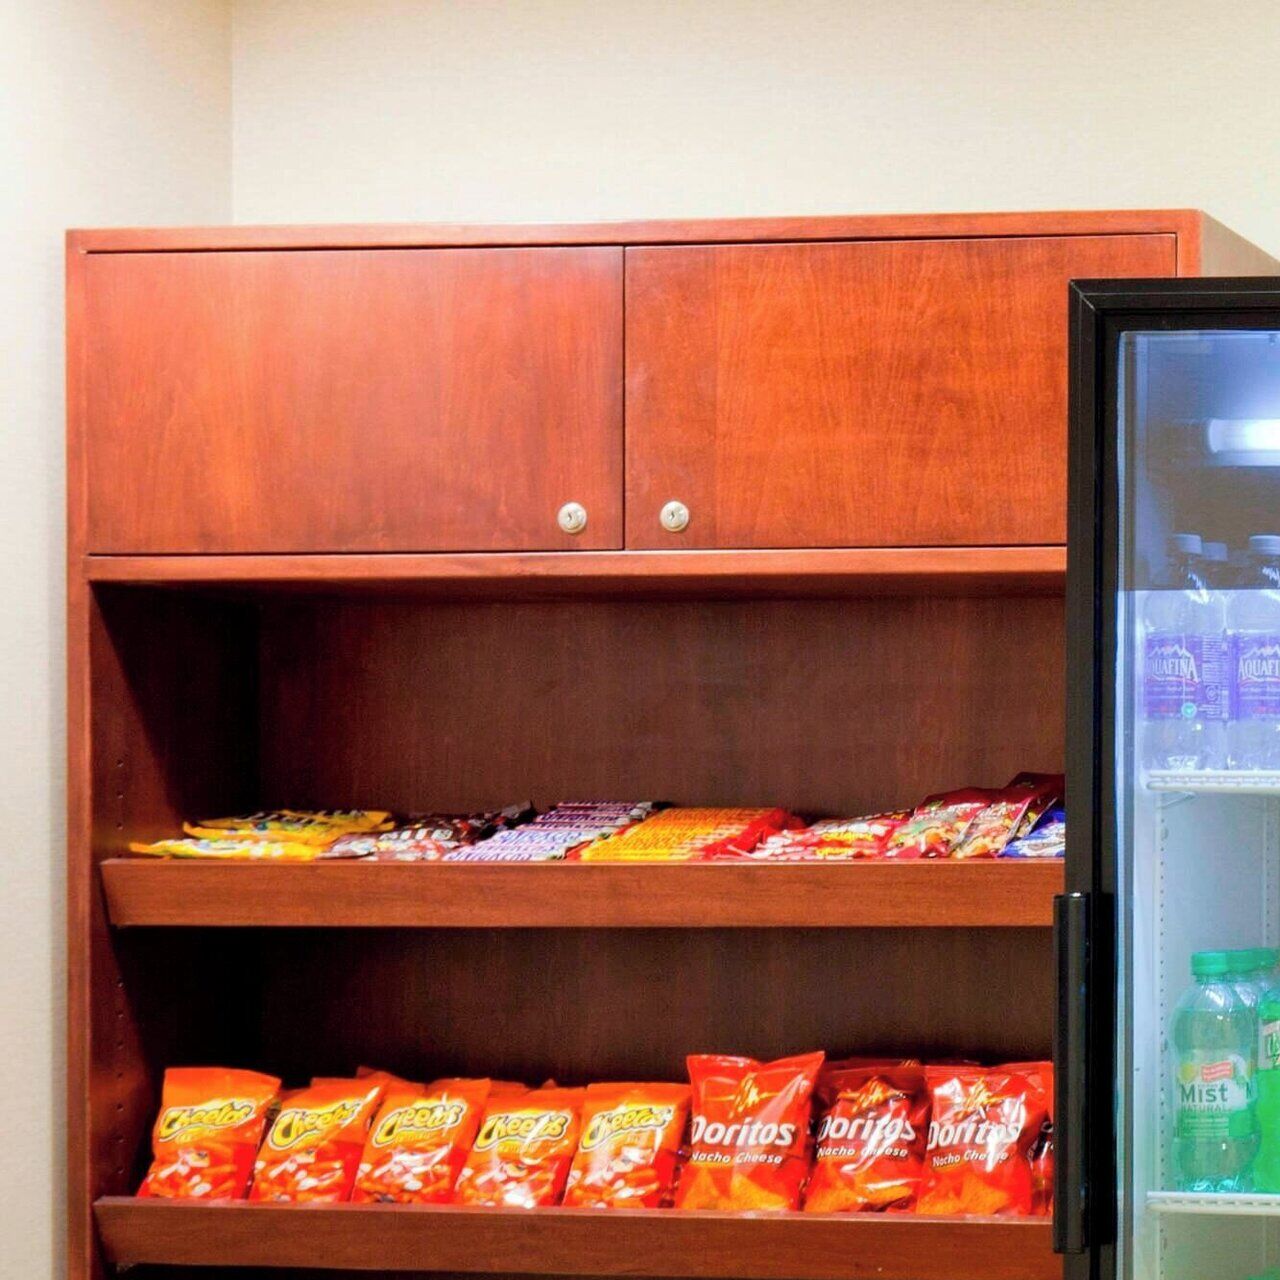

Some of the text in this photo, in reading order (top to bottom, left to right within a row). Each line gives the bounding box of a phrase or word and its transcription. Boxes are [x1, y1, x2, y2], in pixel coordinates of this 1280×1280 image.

[1180, 1083, 1229, 1103] Mist
[160, 1100, 255, 1142] Cheetos
[691, 1115, 796, 1146] Doritos
[692, 1152, 783, 1165] Nacho Cheese
[817, 1146, 856, 1159] Nacho
[932, 1153, 961, 1168] Nacho
